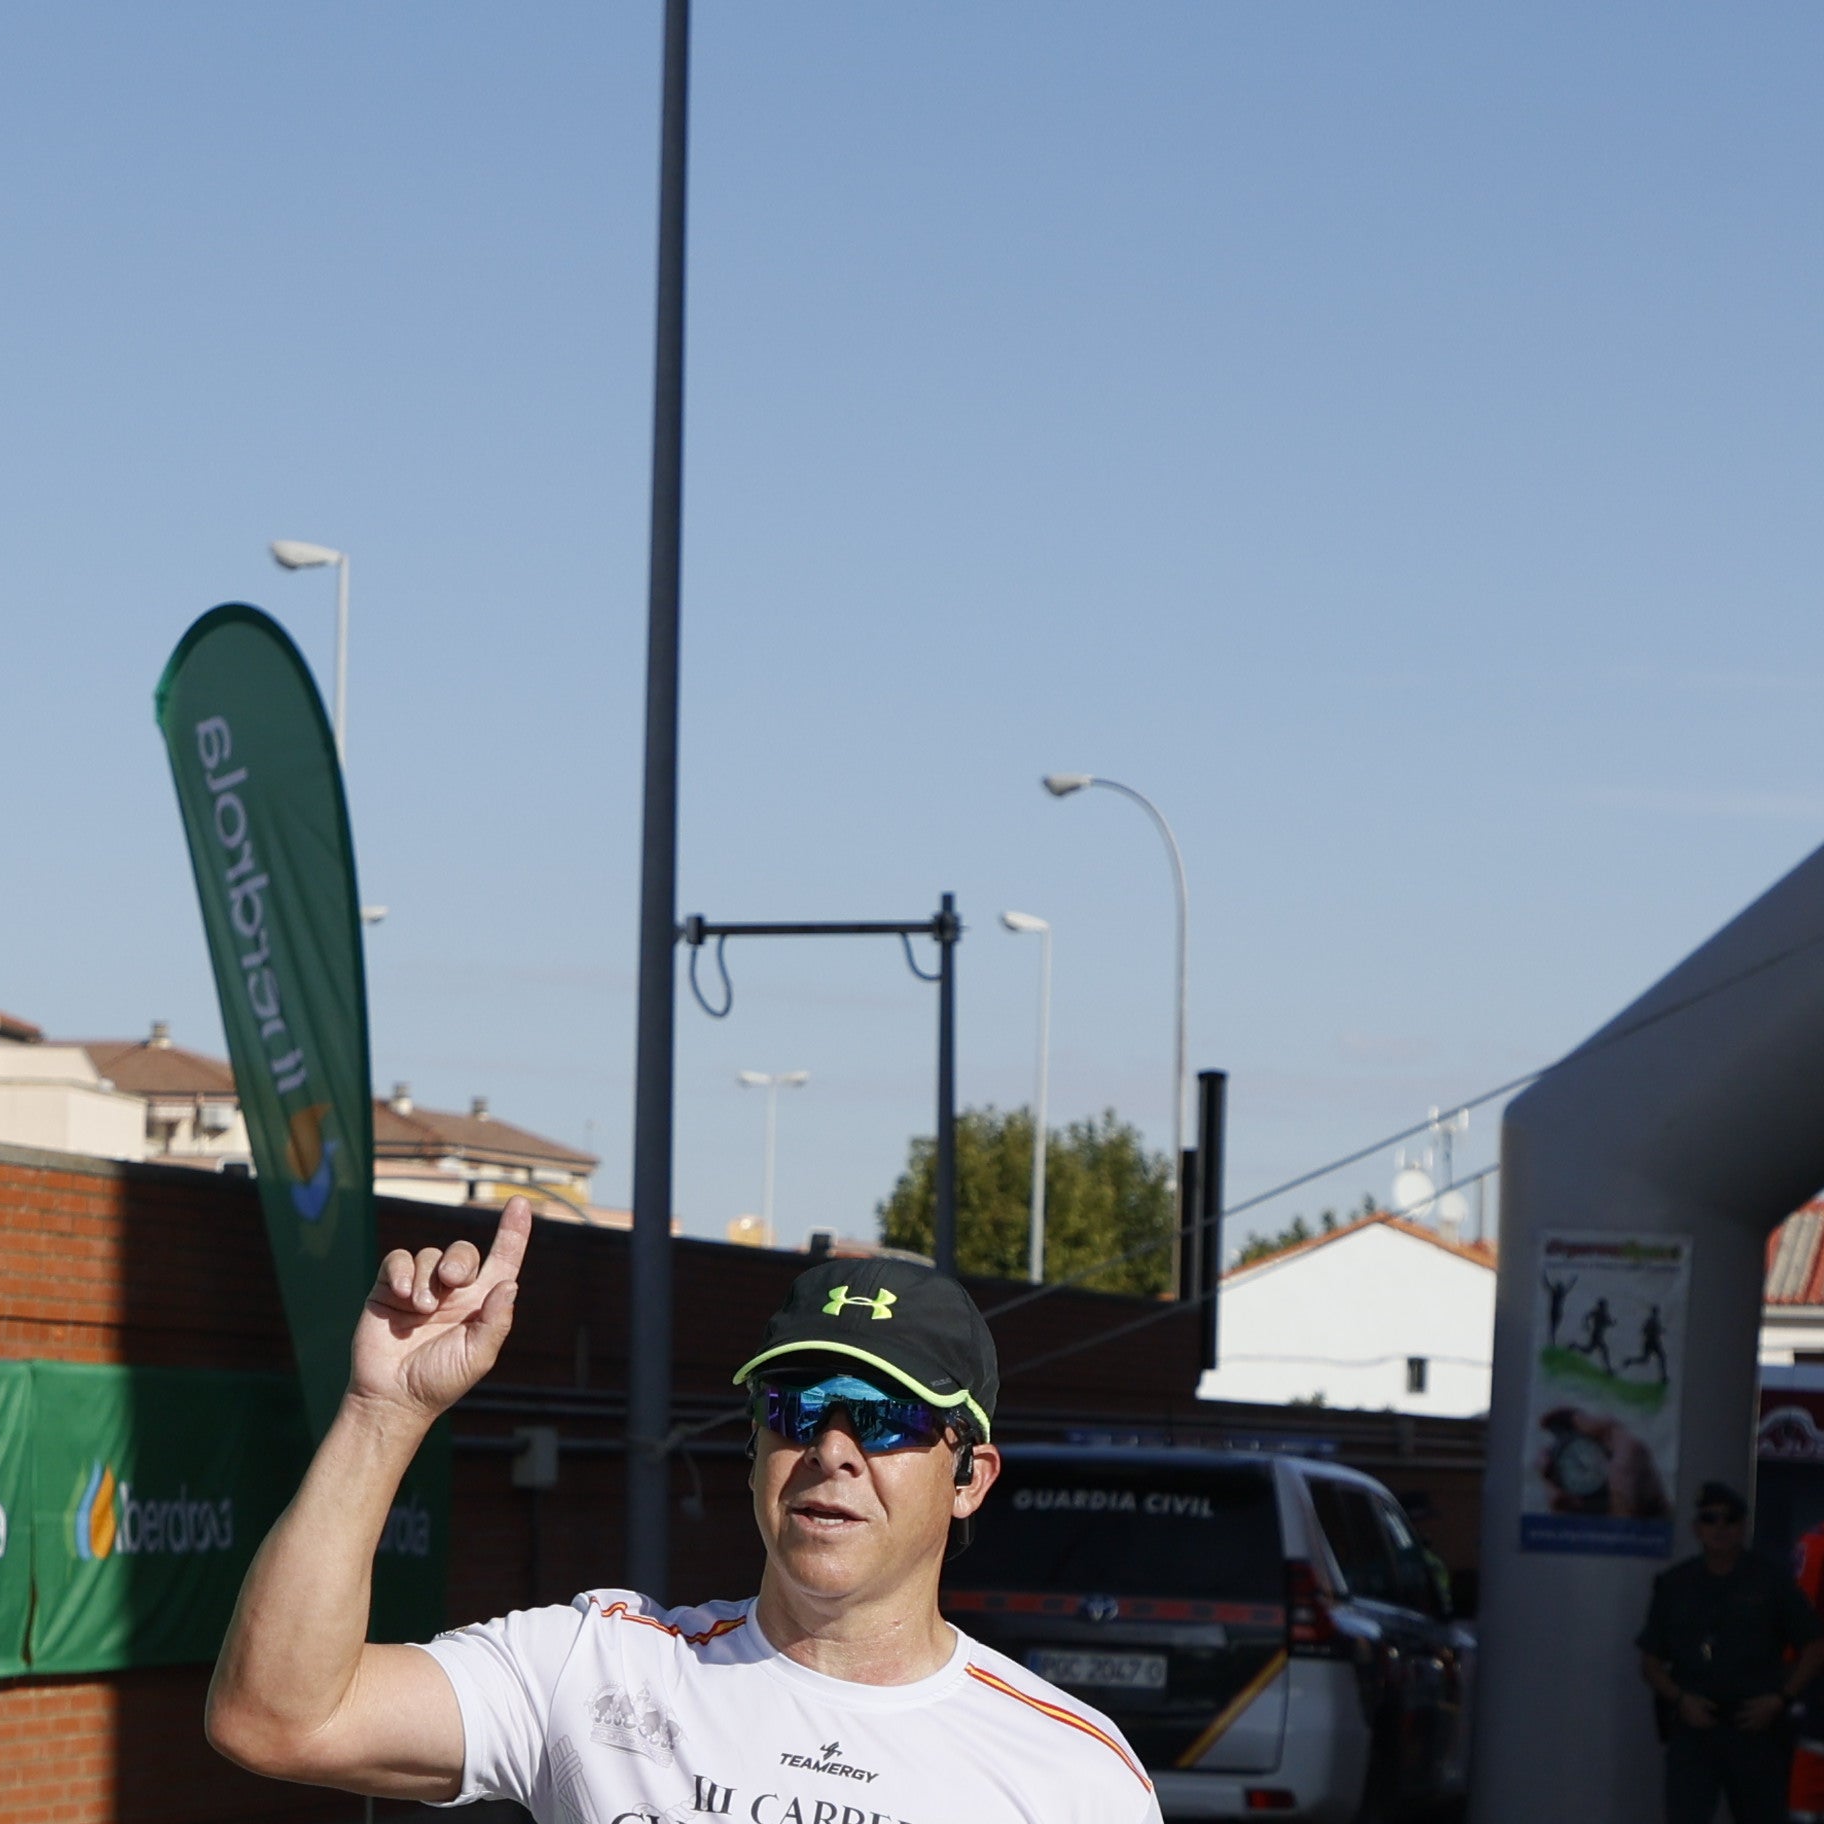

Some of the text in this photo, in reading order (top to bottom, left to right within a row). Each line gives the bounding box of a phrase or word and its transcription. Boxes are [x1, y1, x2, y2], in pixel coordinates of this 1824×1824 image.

[1012, 1488, 1216, 1519] GUARDIA CIVIL
[779, 1752, 880, 1784] TEAMERGY
[690, 1774, 737, 1815] III
